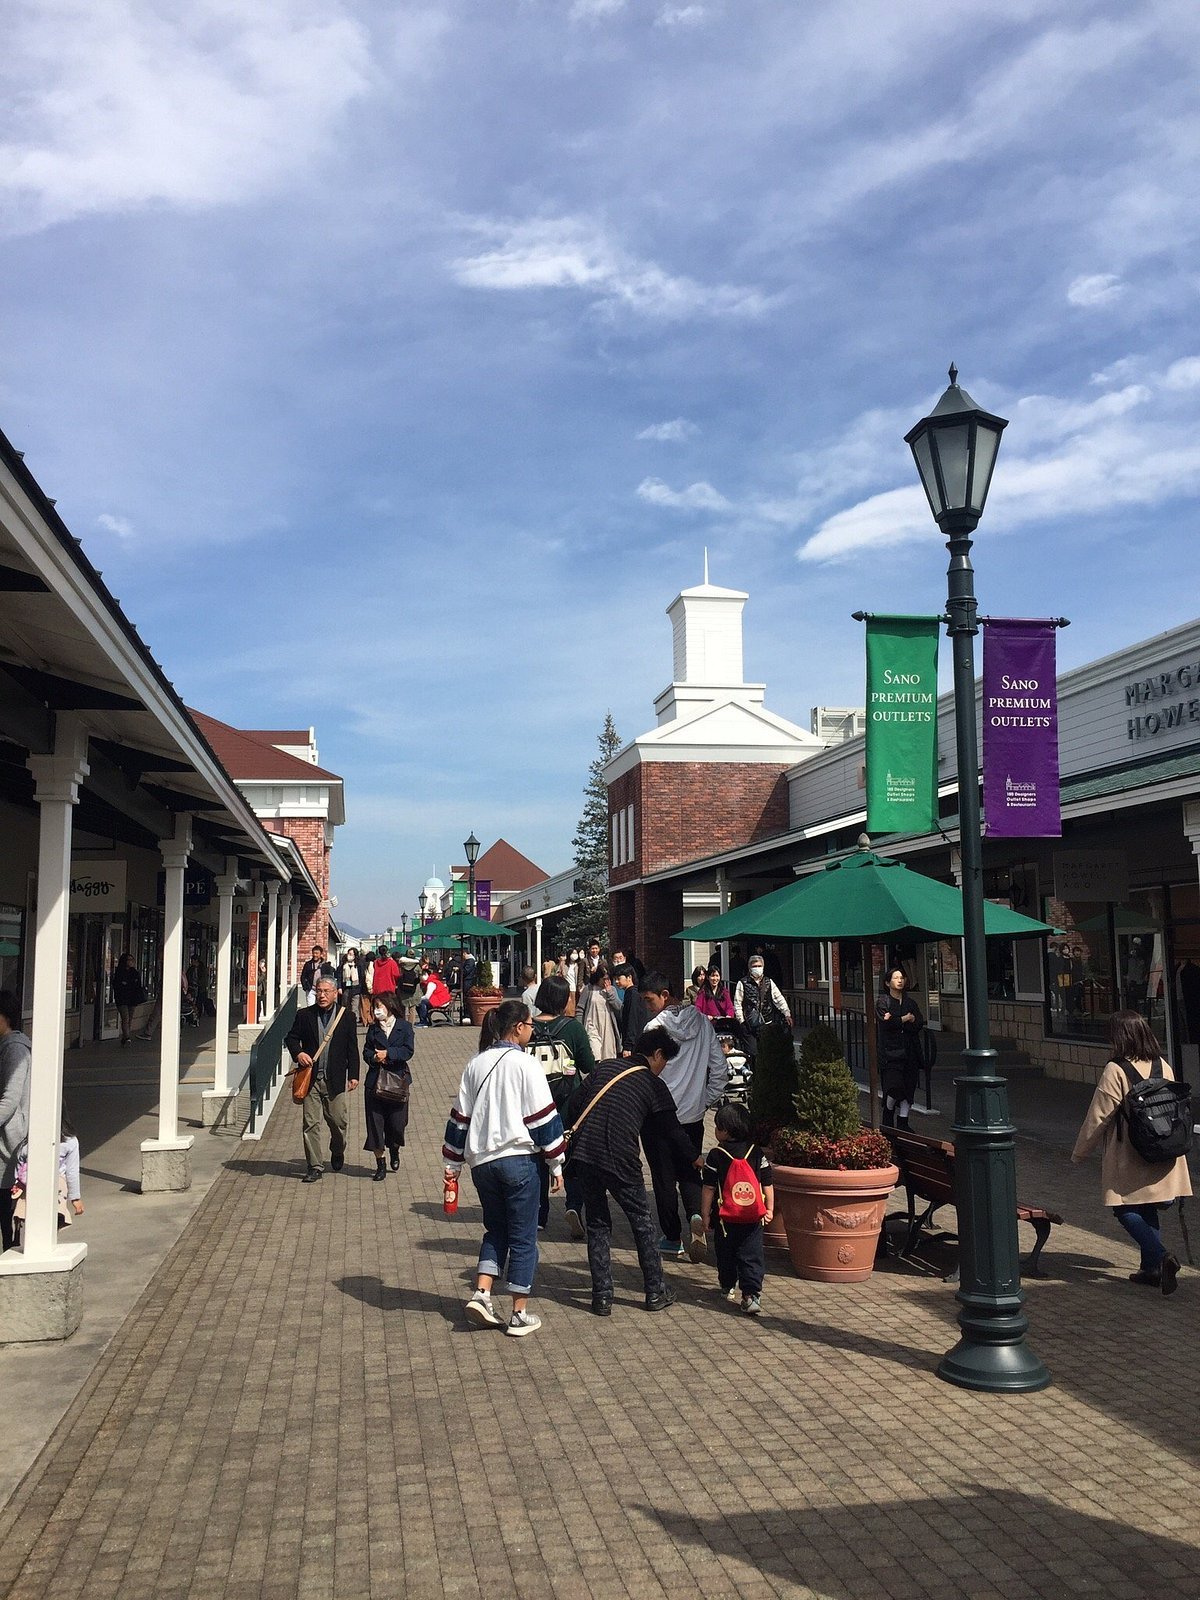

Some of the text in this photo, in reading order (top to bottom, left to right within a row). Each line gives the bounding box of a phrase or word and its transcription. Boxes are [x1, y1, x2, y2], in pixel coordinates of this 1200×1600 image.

[1125, 664, 1200, 706] MARG
[871, 692, 933, 703] PREMIUM
[989, 697, 1051, 709] PREMIUM
[872, 711, 932, 722] OUTLETS
[990, 716, 1051, 727] OUTLETS
